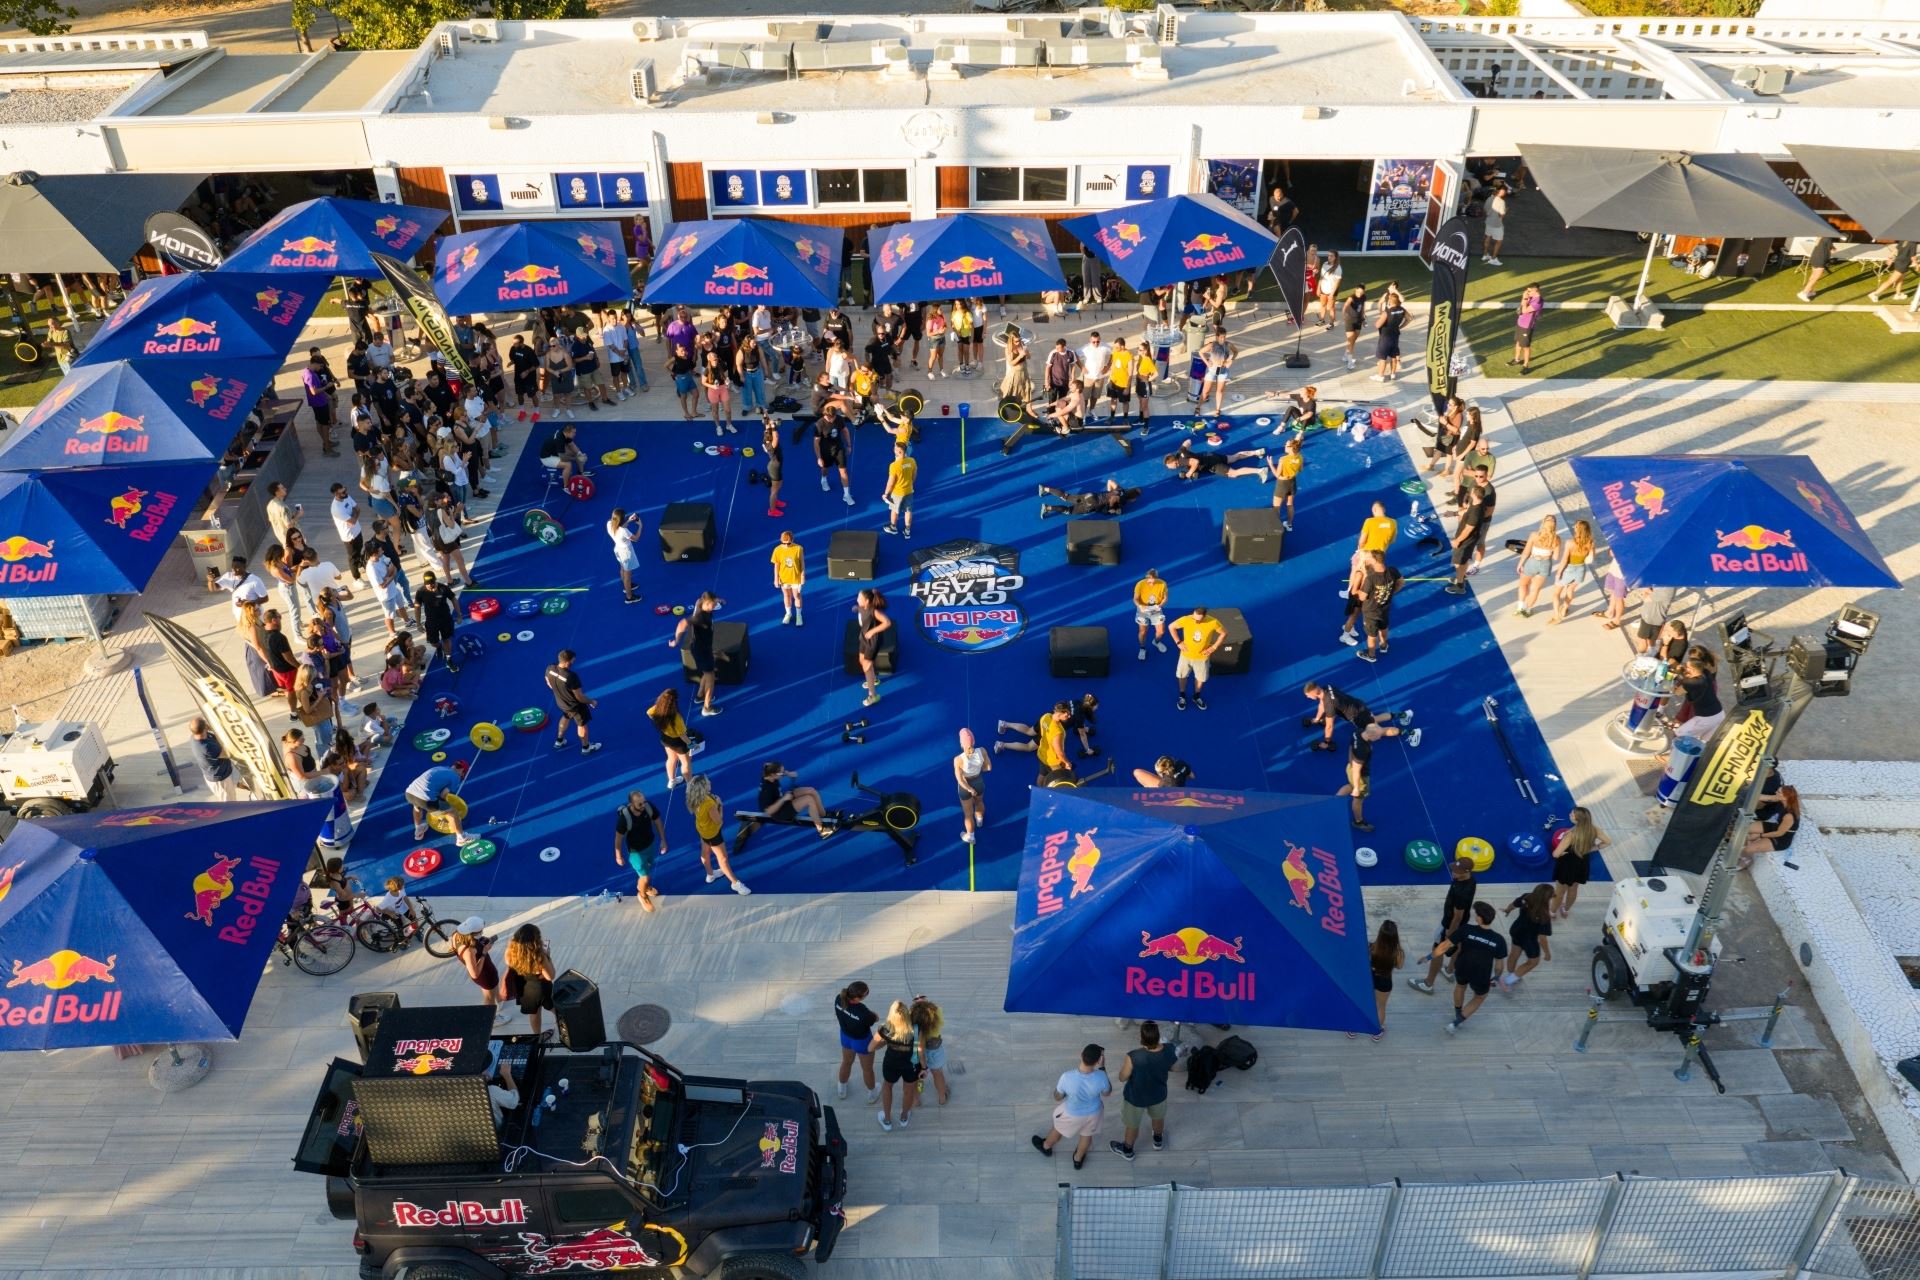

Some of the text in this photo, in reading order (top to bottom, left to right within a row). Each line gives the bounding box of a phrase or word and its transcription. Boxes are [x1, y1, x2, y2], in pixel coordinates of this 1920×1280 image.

[510, 191, 538, 200] PUMA
[1086, 182, 1113, 191] PUMA
[388, 220, 421, 250] Red Bull
[1096, 228, 1133, 260] Red Bull
[270, 254, 338, 268] Red Bull
[1182, 246, 1245, 270] Red Bull
[498, 280, 568, 300] Red Bull
[705, 281, 773, 296] Red Bull
[934, 272, 1003, 291] Red Bull
[272, 291, 305, 325] Red Bull
[143, 337, 221, 355] Red Bull
[208, 378, 249, 420] Red Bull
[64, 435, 149, 454] Red Bull
[130, 491, 178, 542] Red Bull
[1602, 481, 1646, 533] Red Bull
[209, 541, 225, 552] Bull
[9, 562, 58, 583] Bull
[1710, 552, 1809, 573] Red Bull
[911, 575, 1024, 597] CLASH
[926, 590, 1007, 608] GYM
[923, 609, 1019, 628] Red Bull
[1698, 716, 1766, 801] TECHNOGYM
[1132, 791, 1245, 805] Red Bull
[1037, 831, 1069, 915] Red Bull
[219, 856, 281, 945] Red Bull
[1311, 846, 1346, 936] Red Bull
[1126, 966, 1256, 1001] Red Bull
[53, 990, 122, 1024] Bull
[394, 1038, 463, 1056] Red Bull
[780, 1120, 800, 1173] Red Bull
[393, 1198, 527, 1227] Red Bull
